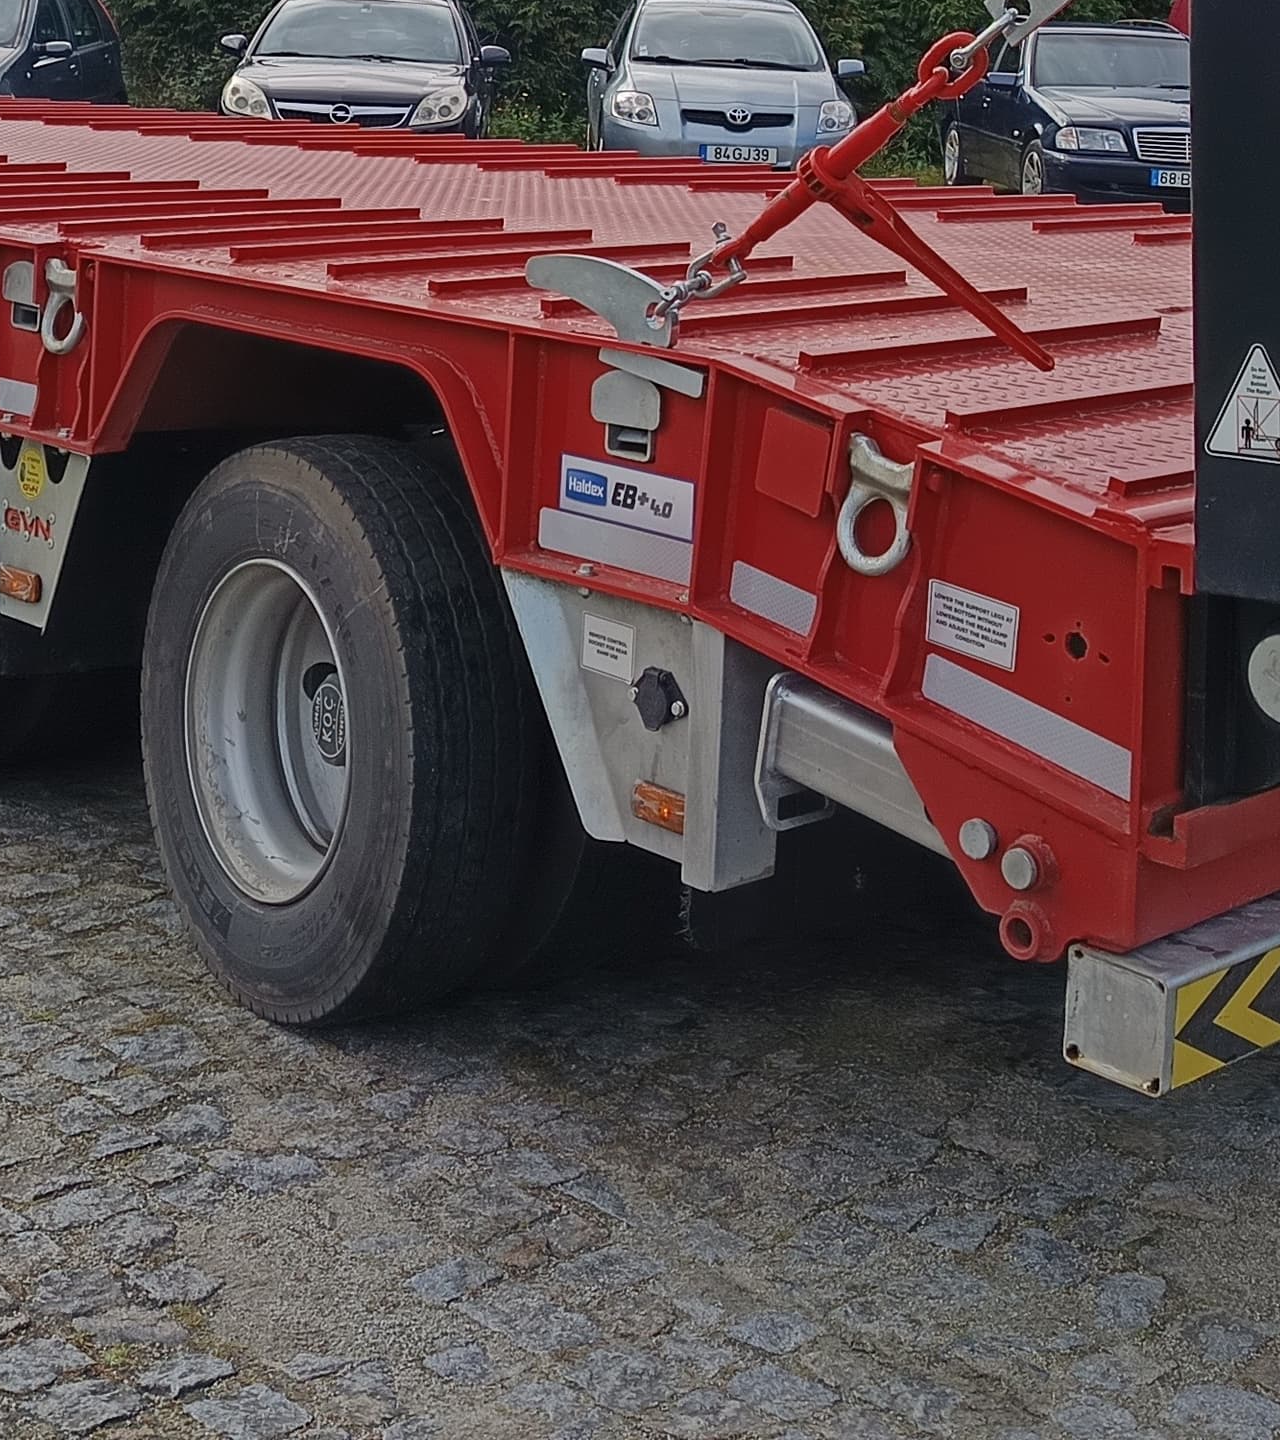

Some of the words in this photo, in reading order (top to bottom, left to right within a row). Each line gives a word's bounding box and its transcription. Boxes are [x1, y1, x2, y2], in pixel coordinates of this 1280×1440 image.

[568, 476, 605, 498] Haldex
[4, 507, 52, 541] GVN
[934, 592, 953, 602] LOWER
[954, 598, 964, 607] THE
[966, 602, 990, 616] SUPPORT
[991, 610, 1005, 621] LEGS
[943, 603, 953, 611] THE
[954, 607, 976, 619] BOTTOM
[977, 615, 1003, 628] WITHOUT
[936, 610, 964, 624] LOWERING
[965, 620, 975, 628] THE
[977, 624, 991, 633] REAR
[992, 629, 1008, 639] RAMP
[948, 623, 968, 633] ADJUST
[970, 630, 980, 638] THE
[981, 634, 1007, 648] BELLOWS
[954, 633, 985, 648] CONDITION
[321, 696, 336, 743] KOÇ
